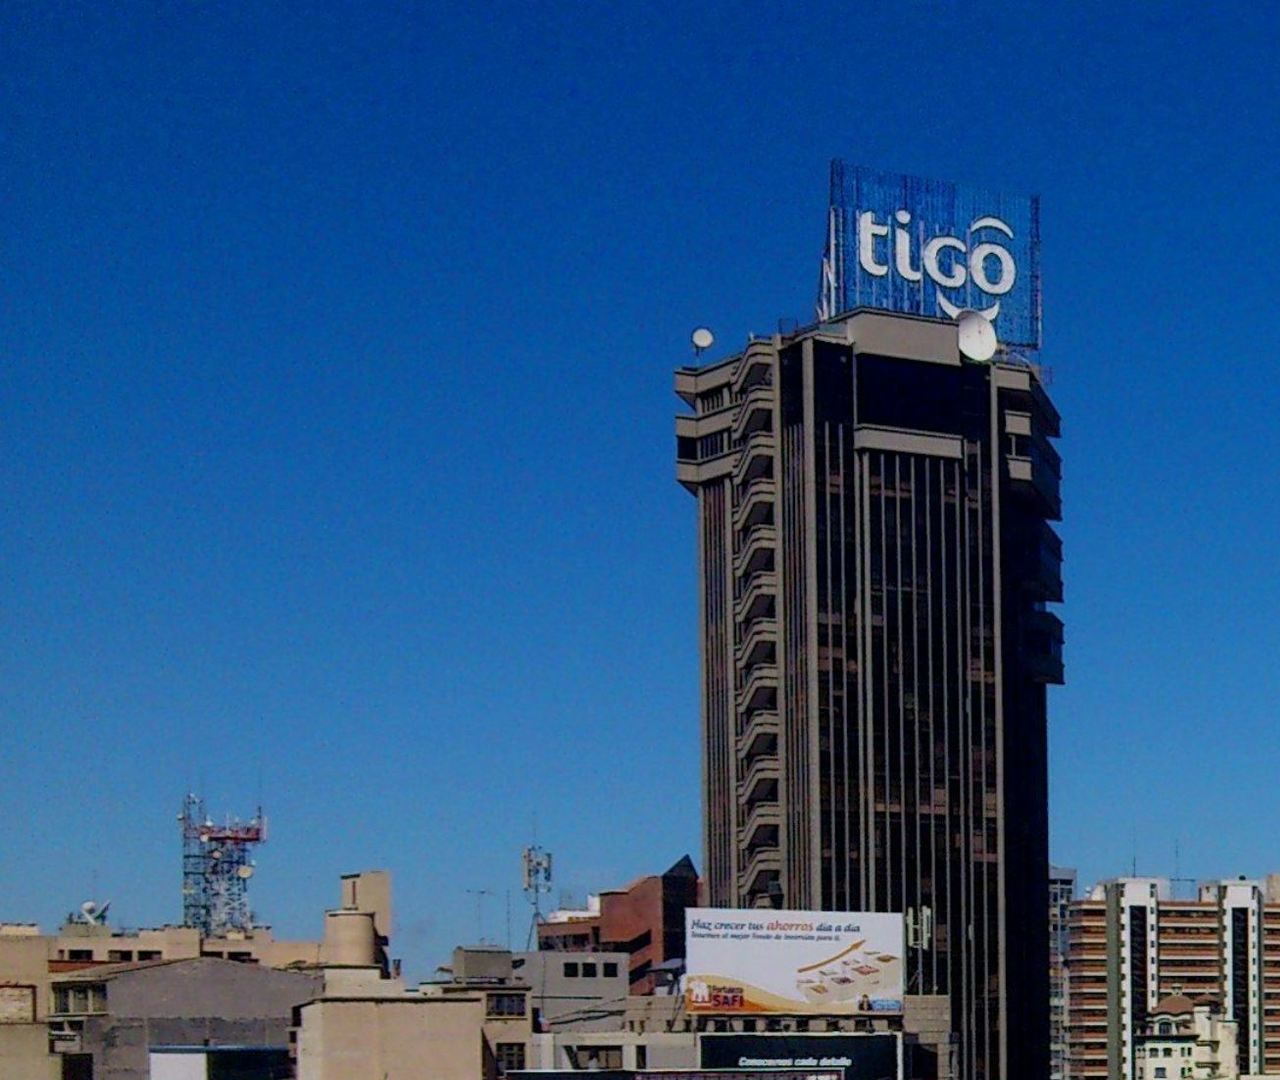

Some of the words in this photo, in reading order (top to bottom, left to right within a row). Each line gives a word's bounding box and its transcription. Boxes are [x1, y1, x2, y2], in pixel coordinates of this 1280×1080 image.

[691, 920, 712, 931] Haz
[714, 921, 746, 931] crecer
[748, 921, 764, 931] tus
[766, 919, 813, 932] ahorros
[712, 995, 744, 1008] SAFI
